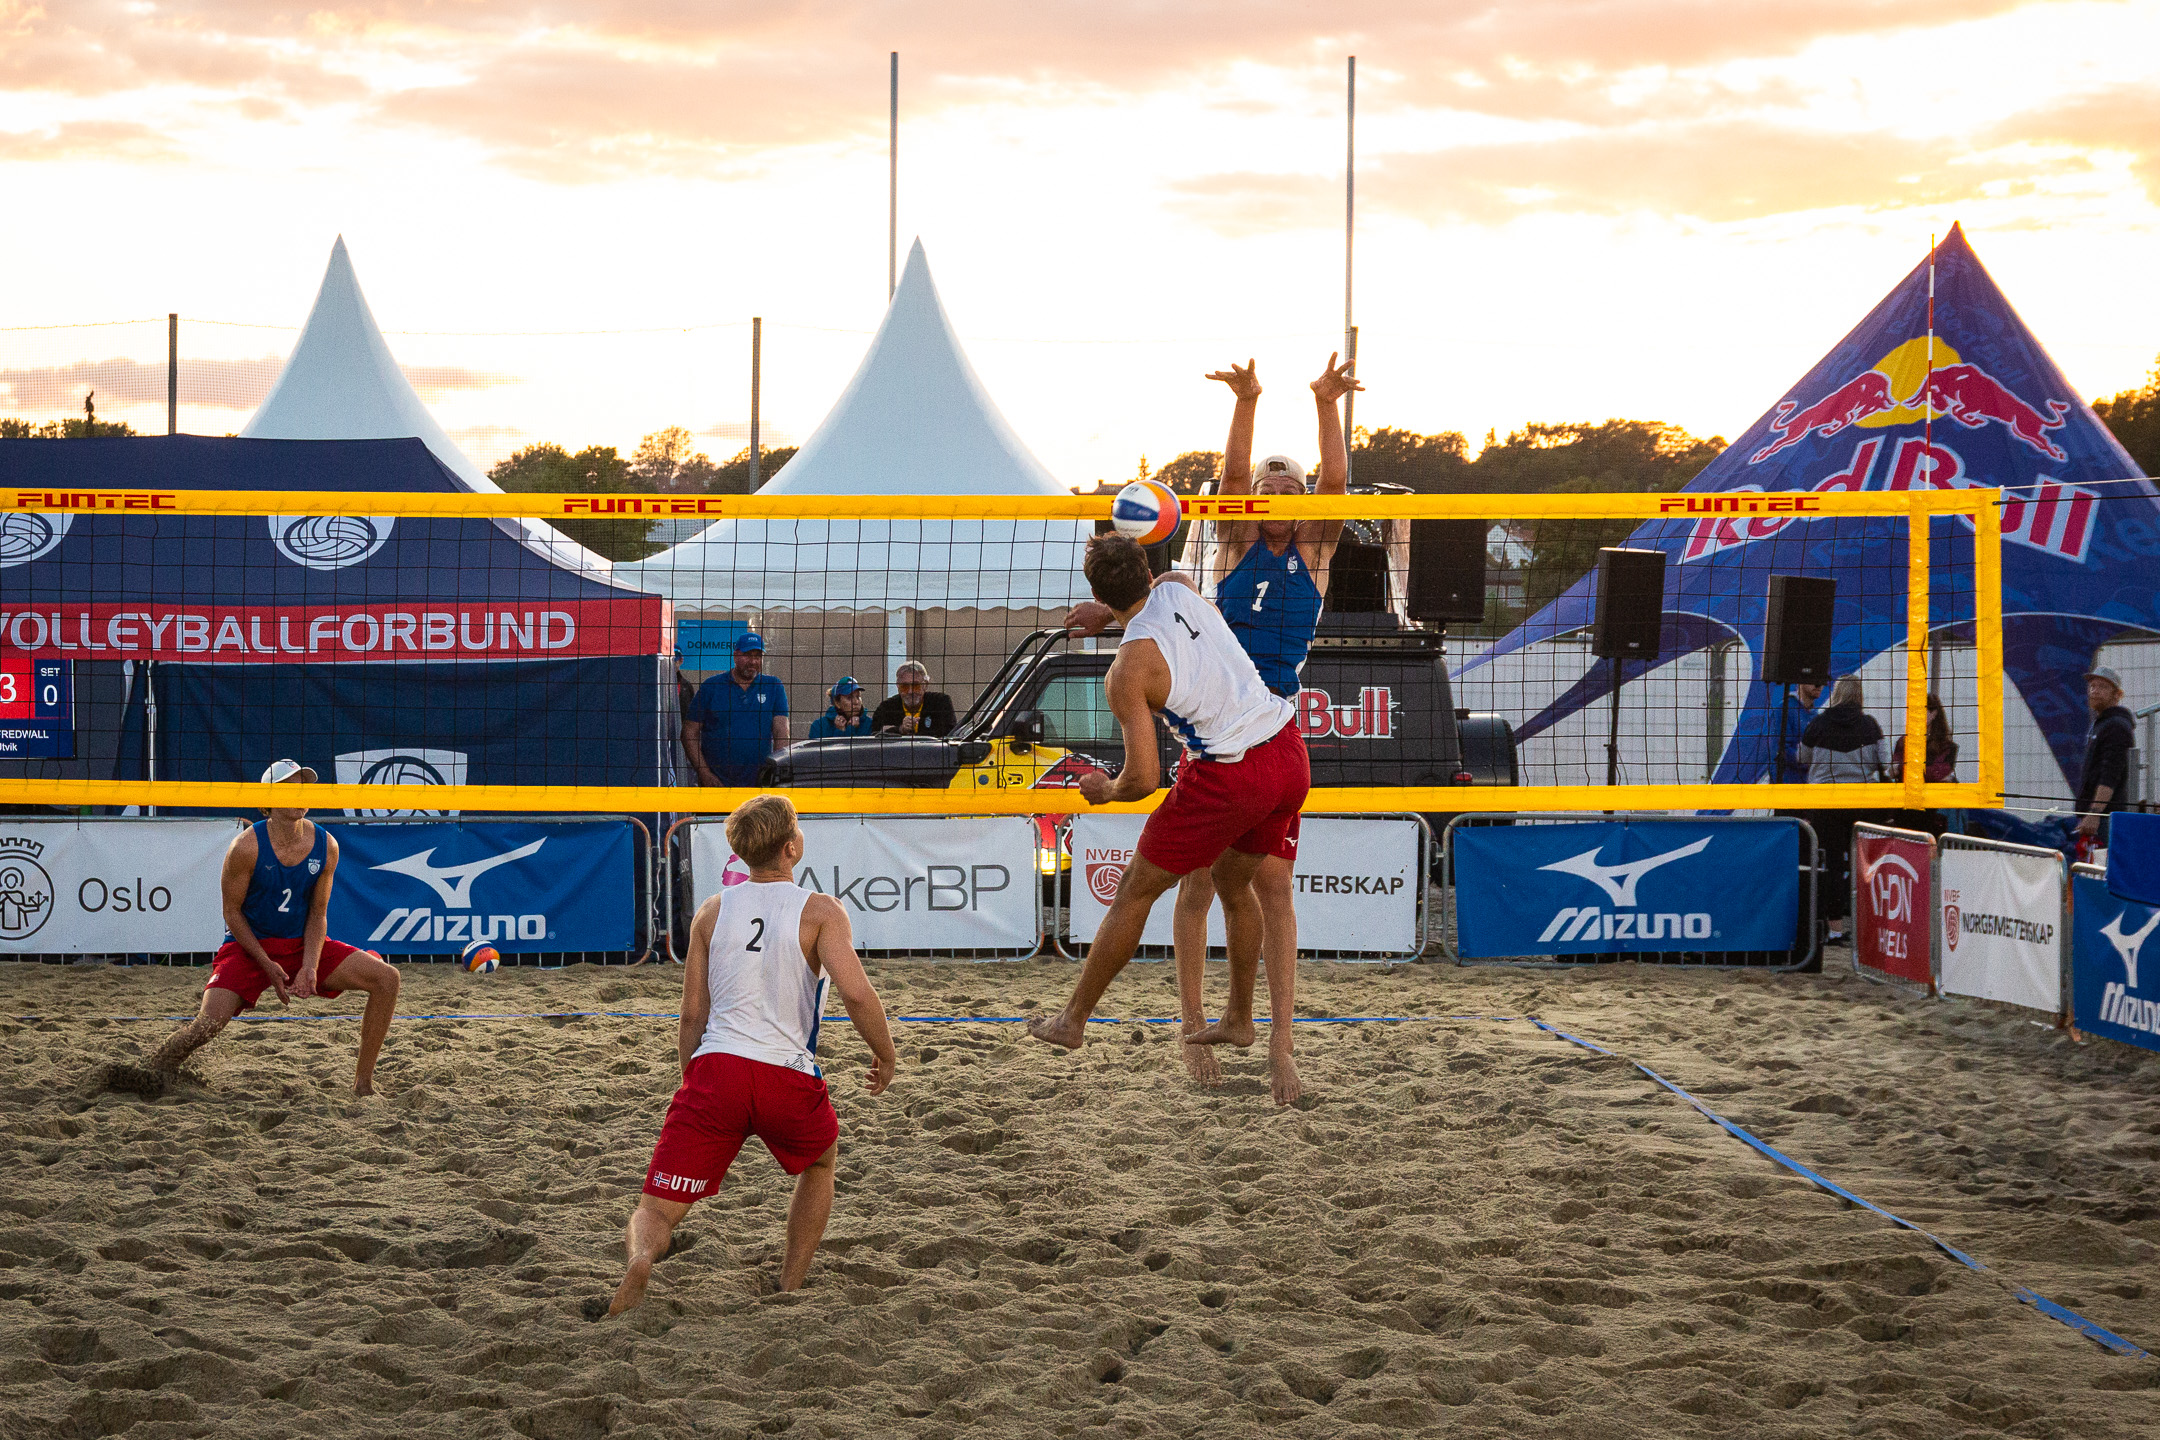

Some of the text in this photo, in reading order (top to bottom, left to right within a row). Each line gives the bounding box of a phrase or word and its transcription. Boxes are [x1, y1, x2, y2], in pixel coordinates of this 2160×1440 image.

[18, 493, 175, 509] FUNTEC
[564, 498, 722, 513] FUNTEC
[1660, 497, 1819, 512] FUNTEC
[1252, 580, 1269, 612] 1
[1174, 612, 1200, 640] 1
[41, 668, 60, 676] SET
[44, 685, 58, 706] 0
[1297, 686, 1391, 738] Bull
[0, 730, 49, 738] REDWALL
[1085, 848, 1133, 861] NVBF
[78, 877, 172, 912] Oslo
[797, 864, 1010, 912] AkerBP
[1292, 874, 1404, 895] TERSKAP
[277, 888, 292, 912] 2
[367, 907, 546, 941] MIZUNO
[746, 917, 764, 952] 2
[1537, 906, 1712, 942] MIZUNO
[2099, 981, 2160, 1036] MIZUN
